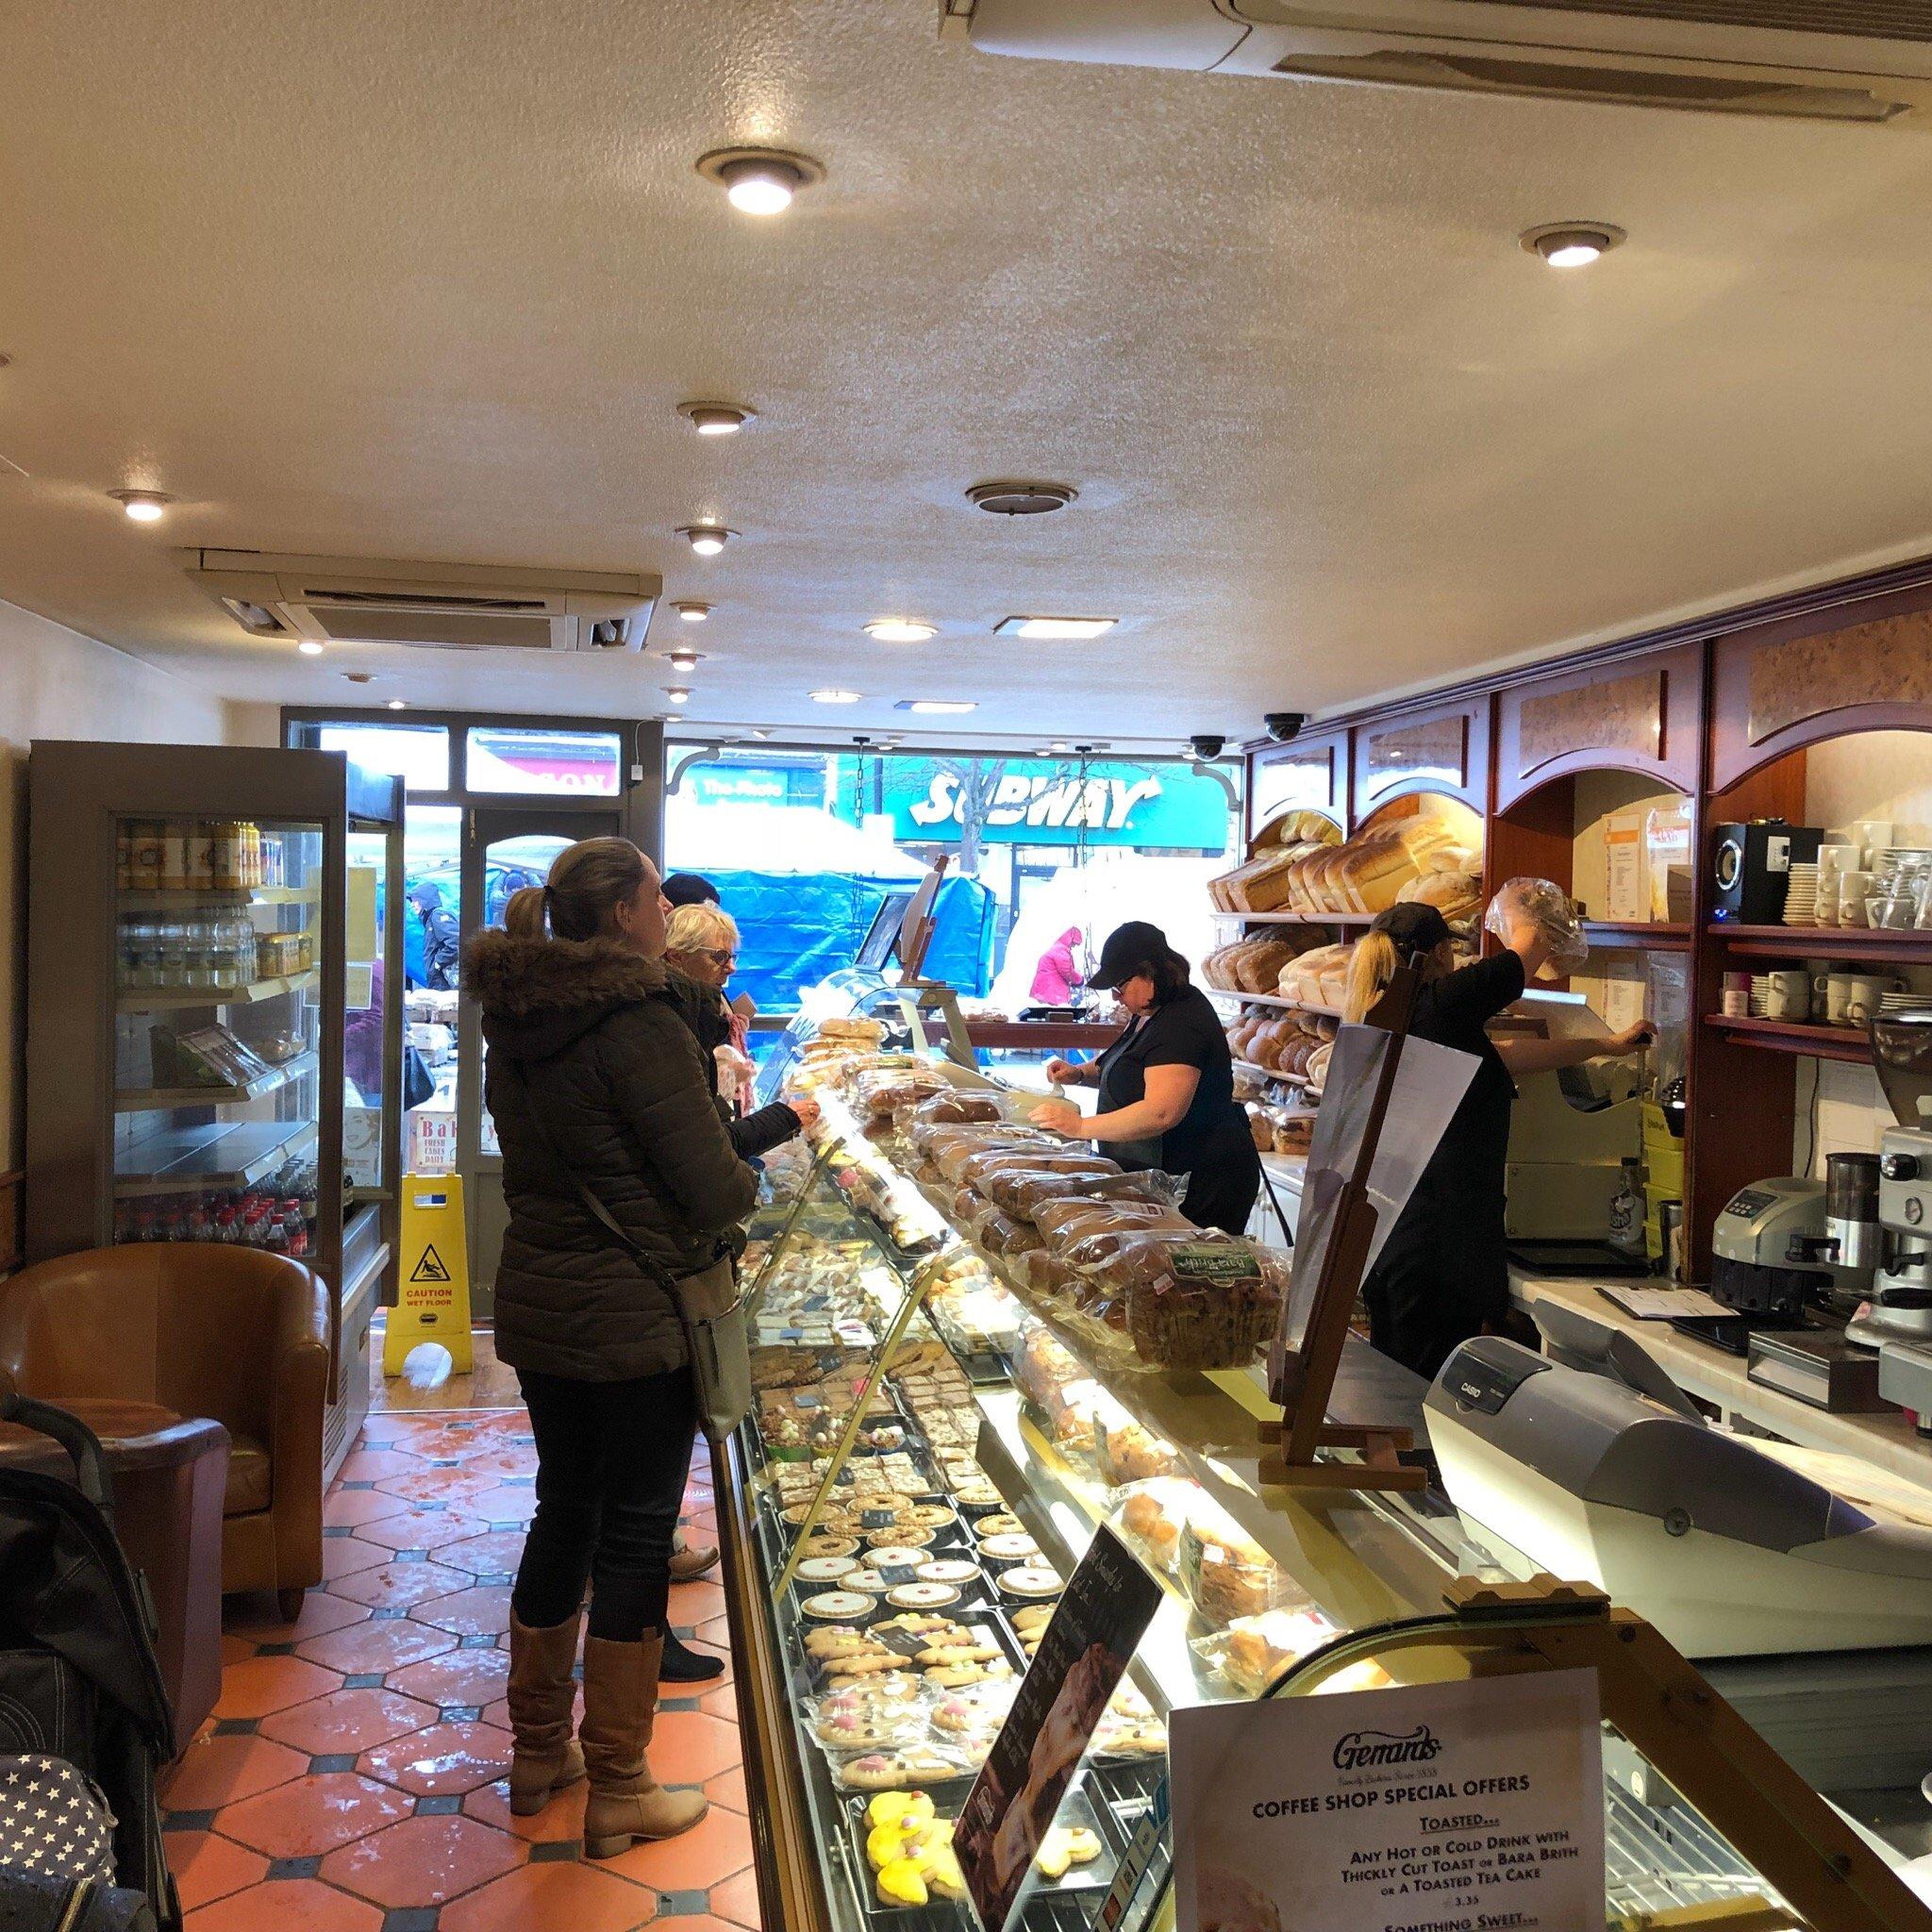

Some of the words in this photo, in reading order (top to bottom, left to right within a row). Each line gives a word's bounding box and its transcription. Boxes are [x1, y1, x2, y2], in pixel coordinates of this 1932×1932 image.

[1461, 1382, 1481, 1398] CASIO
[1253, 1797, 1319, 1818] COFFEE
[1325, 1790, 1378, 1810] SHOP
[1384, 1784, 1457, 1805] SPECIAL
[1463, 1774, 1530, 1796] OFFERS
[1350, 1851, 1381, 1864] ANY
[1445, 1840, 1482, 1854] COLD
[1488, 1836, 1530, 1849] DRINK
[1341, 1868, 1396, 1883] THICKLY
[1401, 1863, 1428, 1876] CUT
[1432, 1858, 1474, 1873] TOAST
[1400, 1883, 1409, 1893] A
[1414, 1876, 1473, 1892] TOASTED
[1476, 1872, 1501, 1885] TEA
[1506, 1868, 1541, 1881] CAKE
